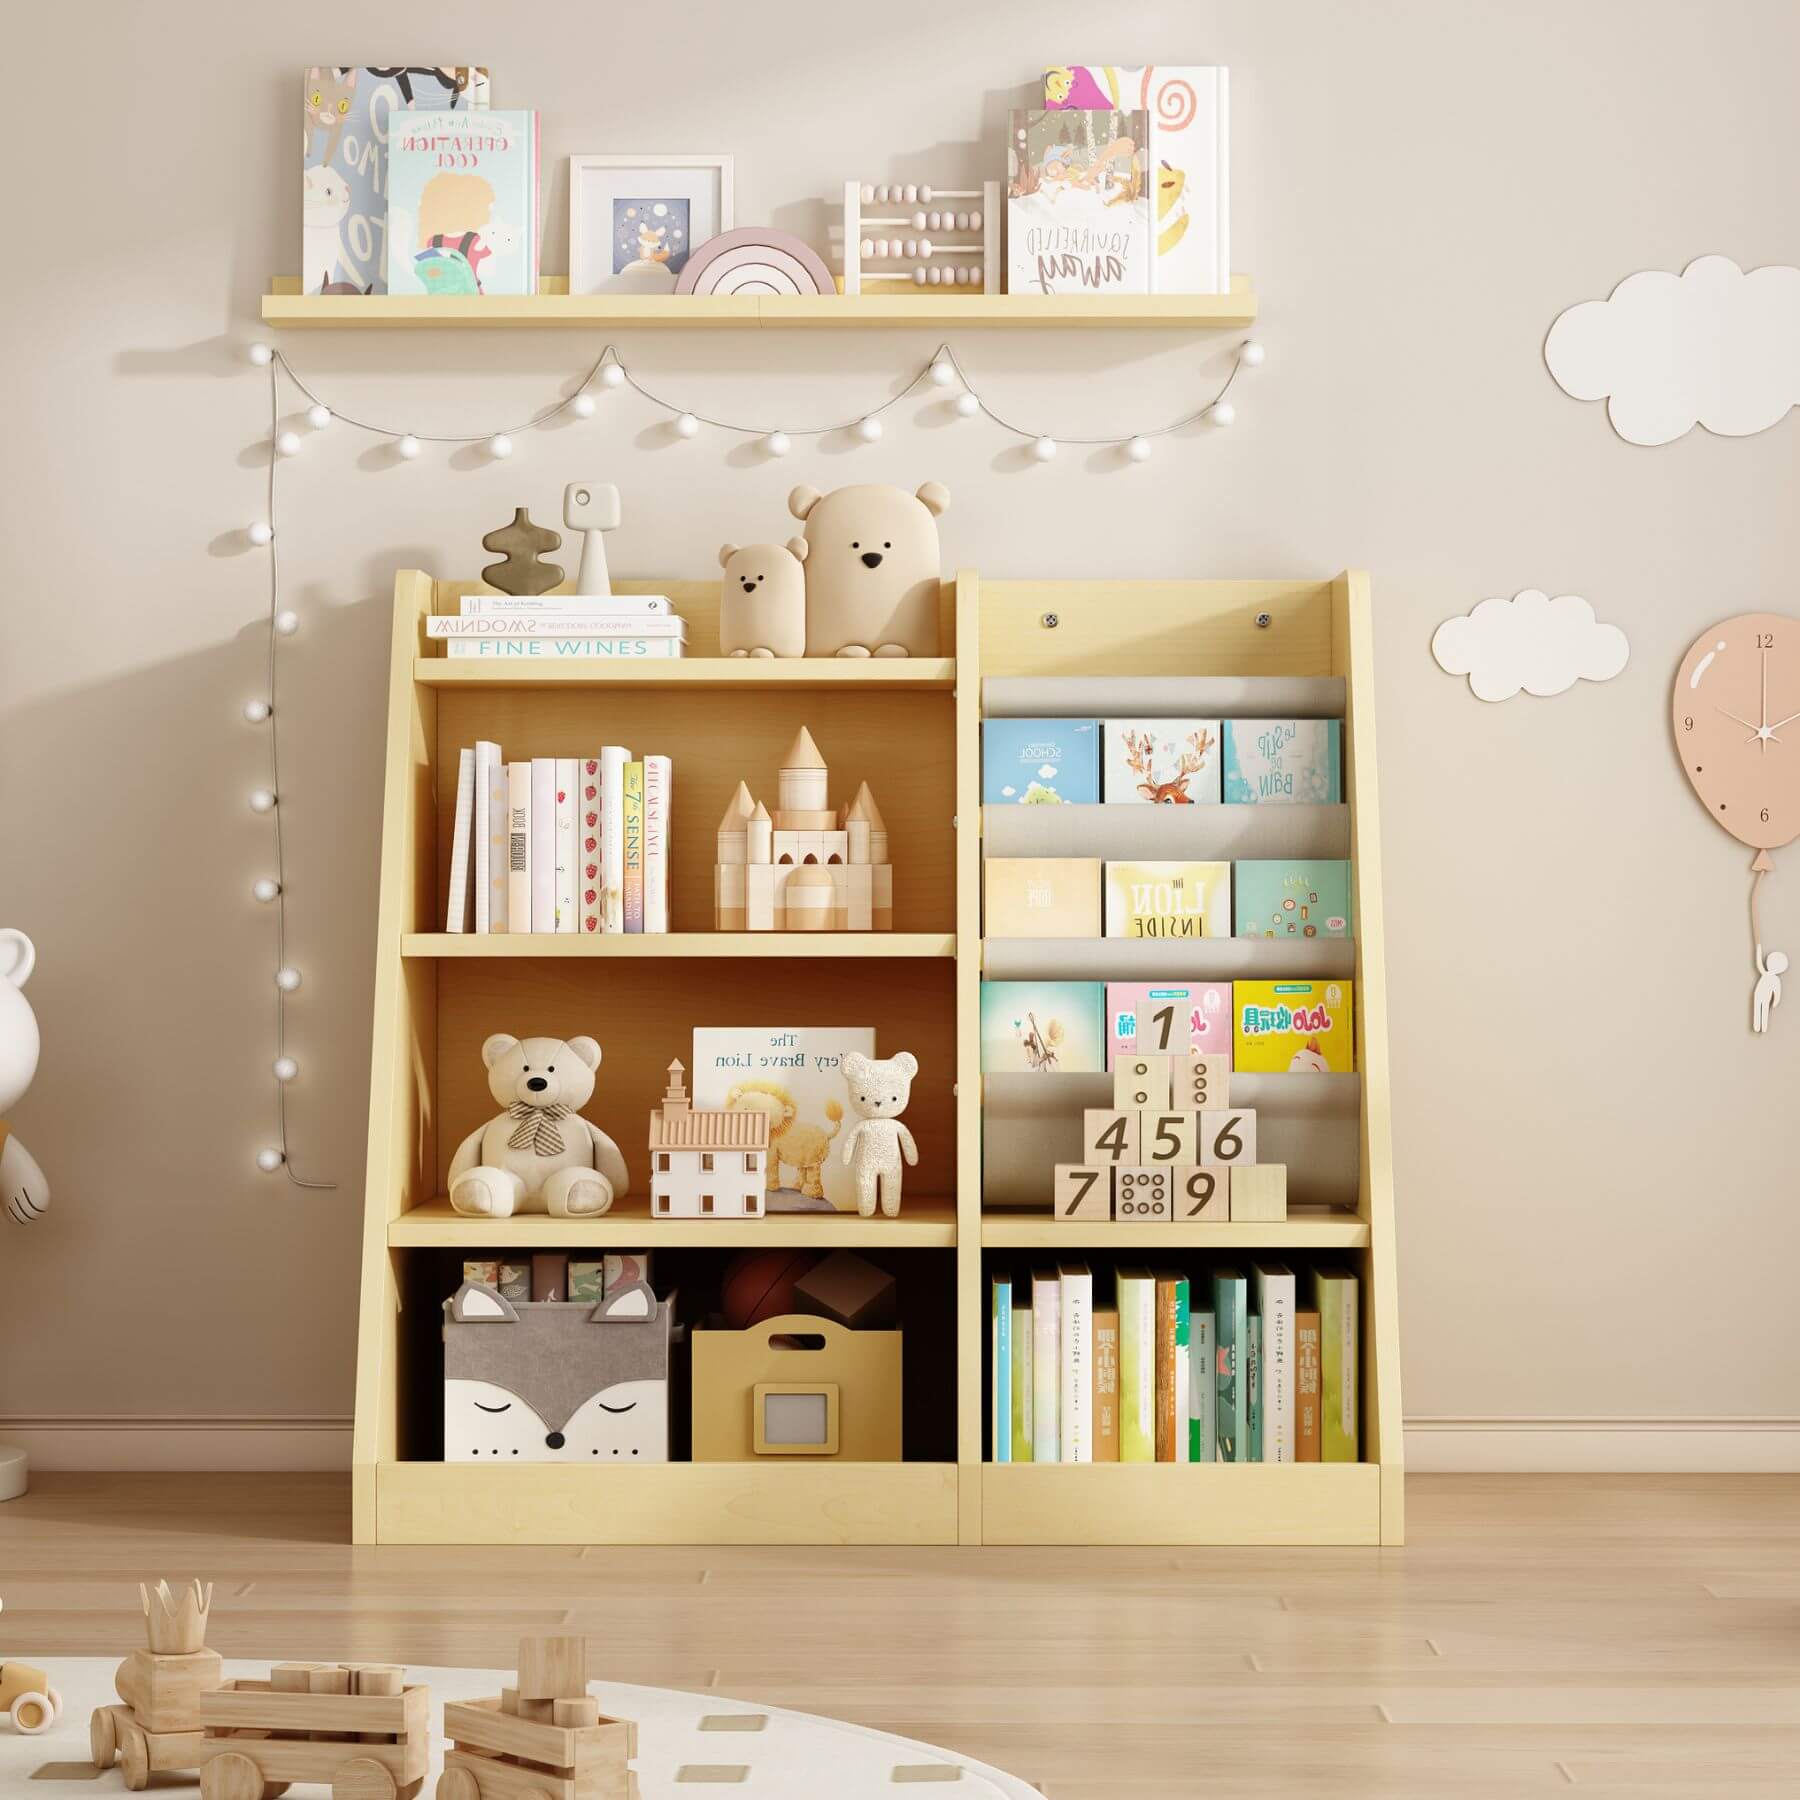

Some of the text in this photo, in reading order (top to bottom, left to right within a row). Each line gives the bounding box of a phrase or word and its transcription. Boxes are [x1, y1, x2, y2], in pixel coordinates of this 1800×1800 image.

[479, 640, 648, 655] FINE WINES
[1756, 634, 1774, 649] 12
[1684, 716, 1694, 731] 9
[1760, 808, 1769, 823] 6
[626, 815, 640, 870] SENSE
[1152, 1006, 1175, 1051] 1
[1094, 1116, 1243, 1160] 4 5 6
[1064, 1172, 1216, 1216] 7 9
